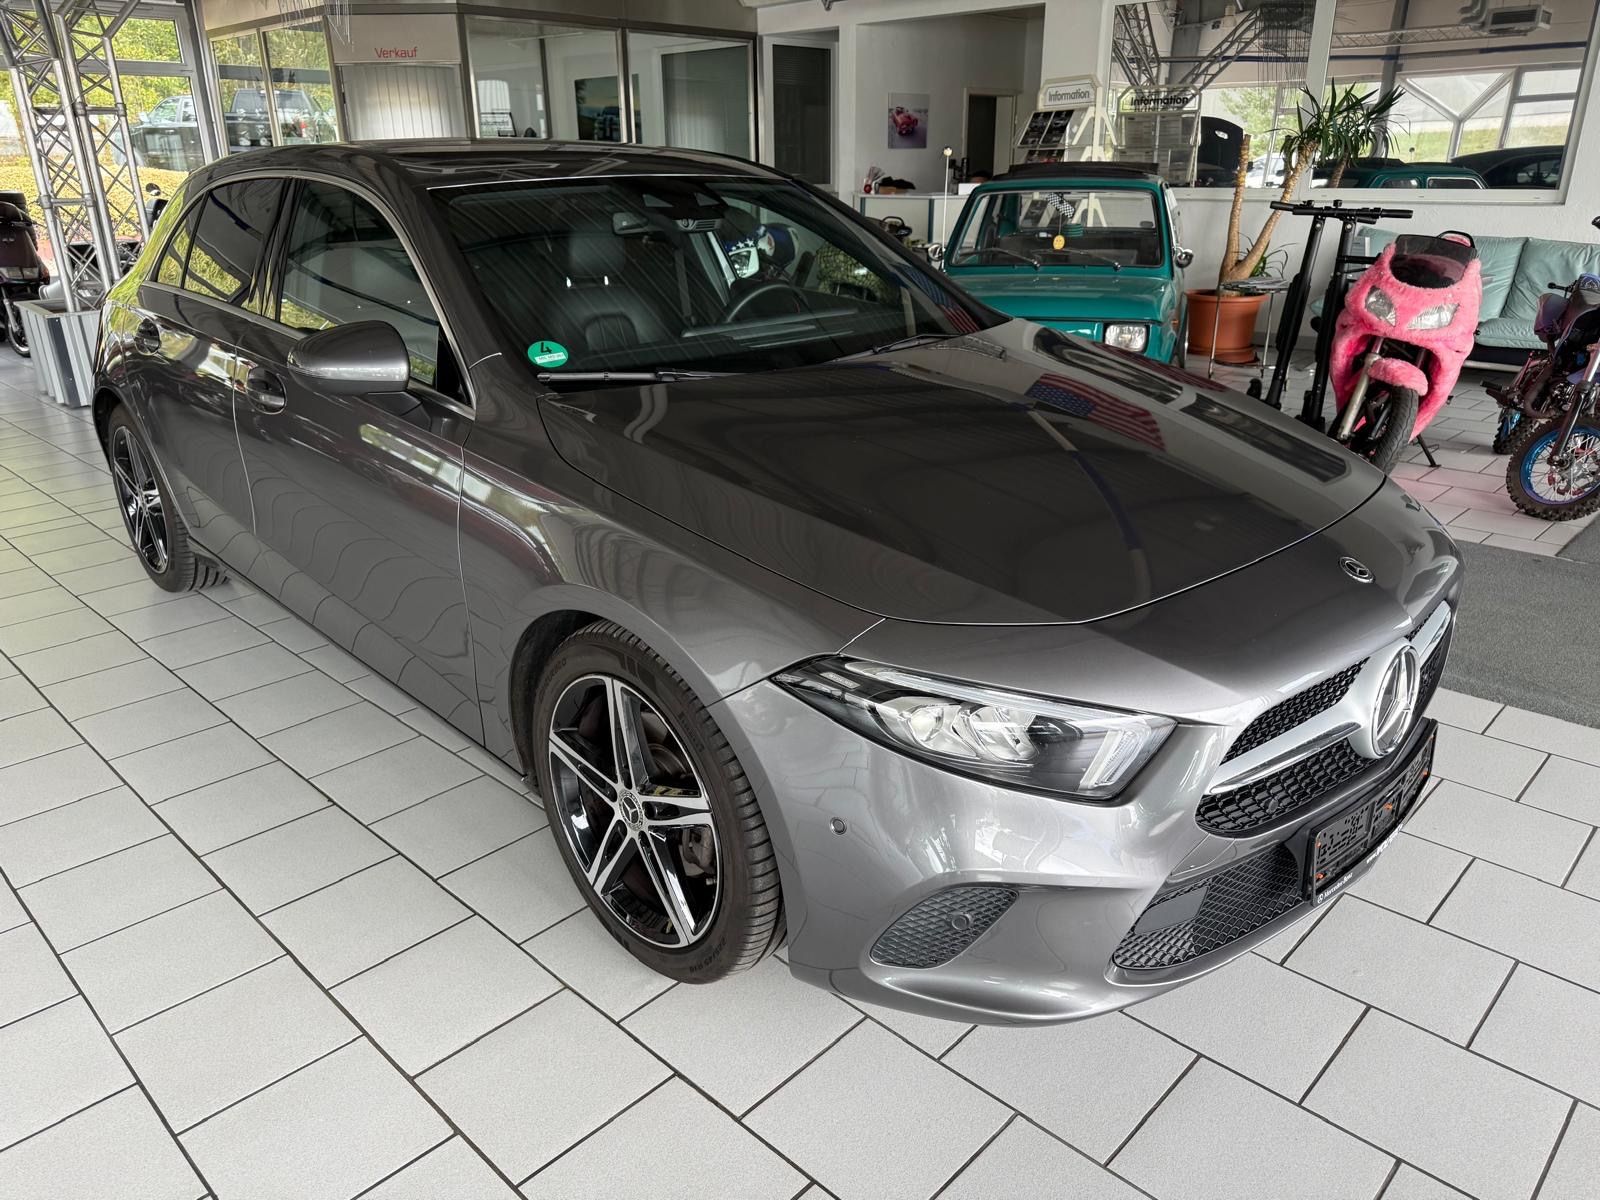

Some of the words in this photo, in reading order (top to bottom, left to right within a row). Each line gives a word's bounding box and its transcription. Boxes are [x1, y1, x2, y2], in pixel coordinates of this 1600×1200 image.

[374, 46, 418, 59] Verkauf
[1048, 88, 1090, 102] Information
[1130, 94, 1190, 107] Information
[540, 342, 552, 354] 4
